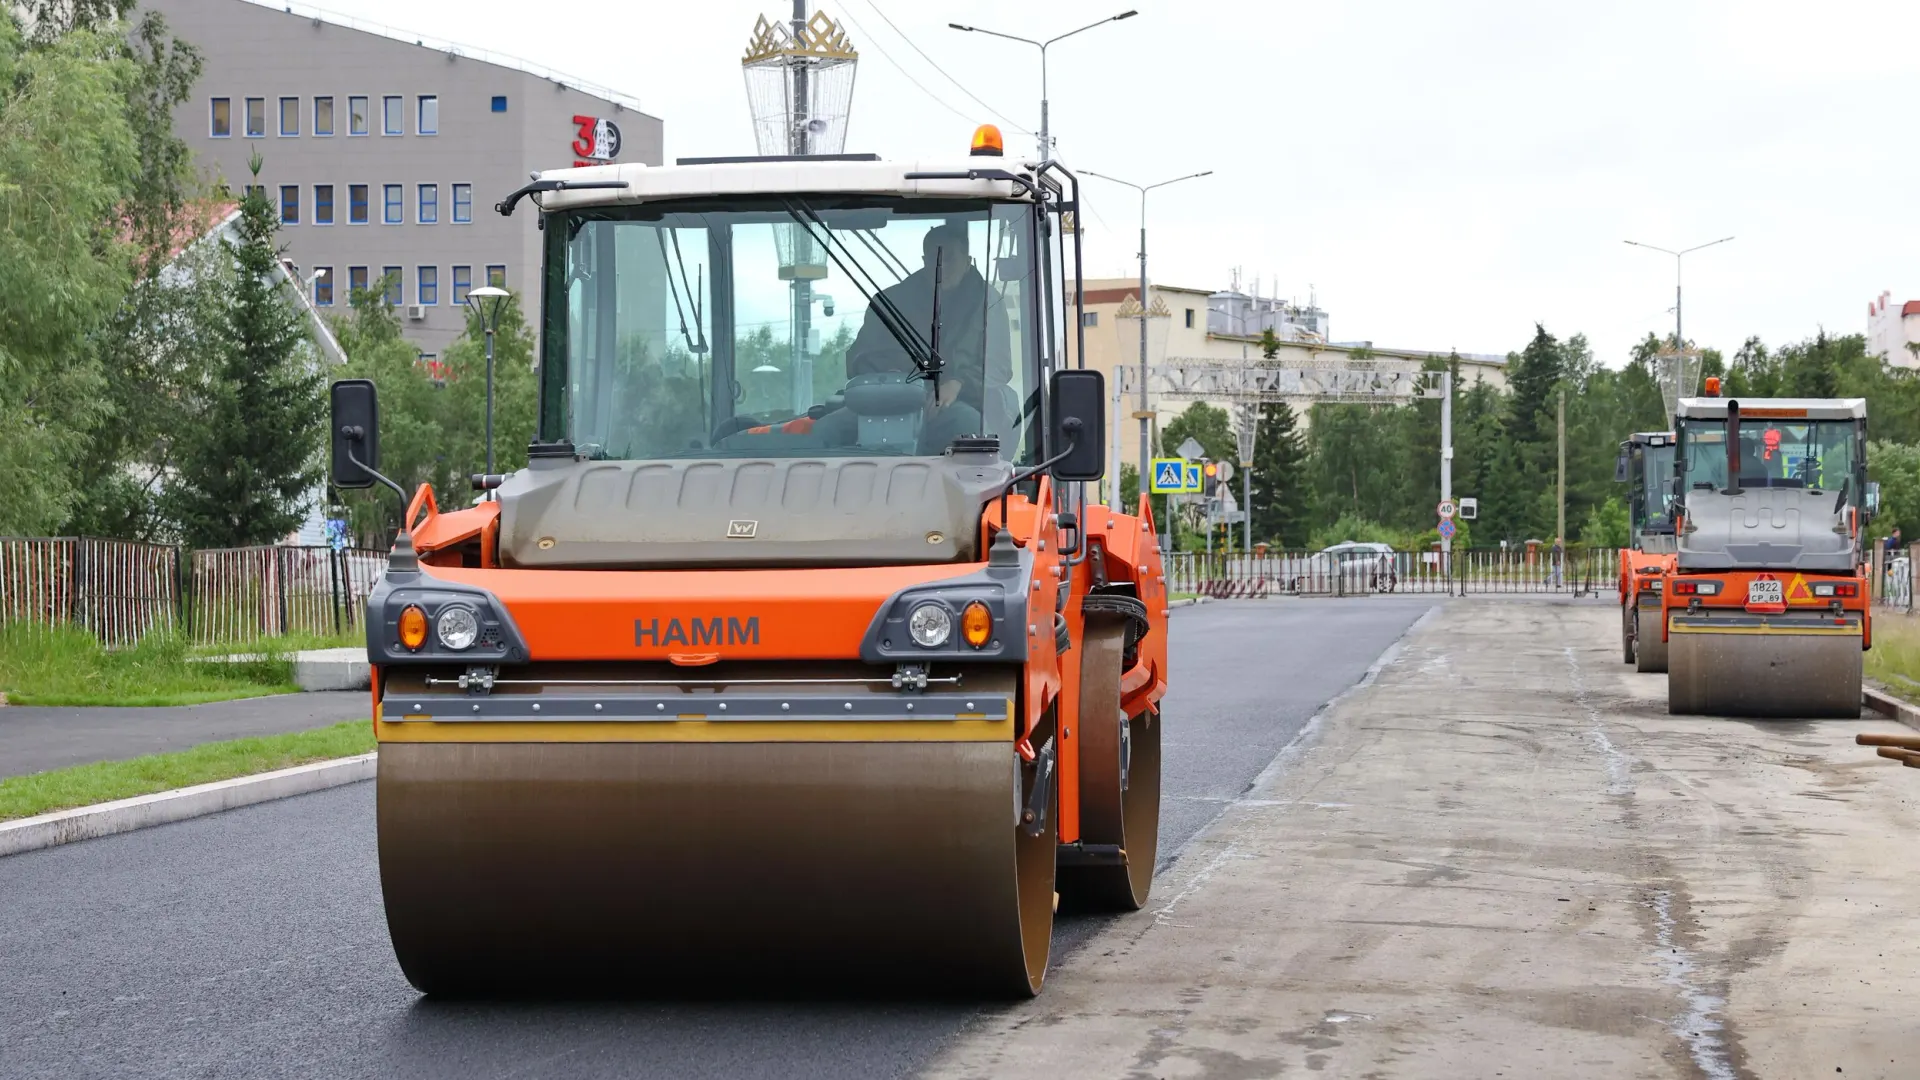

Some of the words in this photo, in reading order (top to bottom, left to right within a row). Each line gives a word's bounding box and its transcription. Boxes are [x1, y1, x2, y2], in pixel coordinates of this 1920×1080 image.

[1441, 504, 1452, 514] 40
[1753, 582, 1778, 592] 1822
[1769, 594, 1780, 602] 89
[634, 616, 760, 648] HAMM
